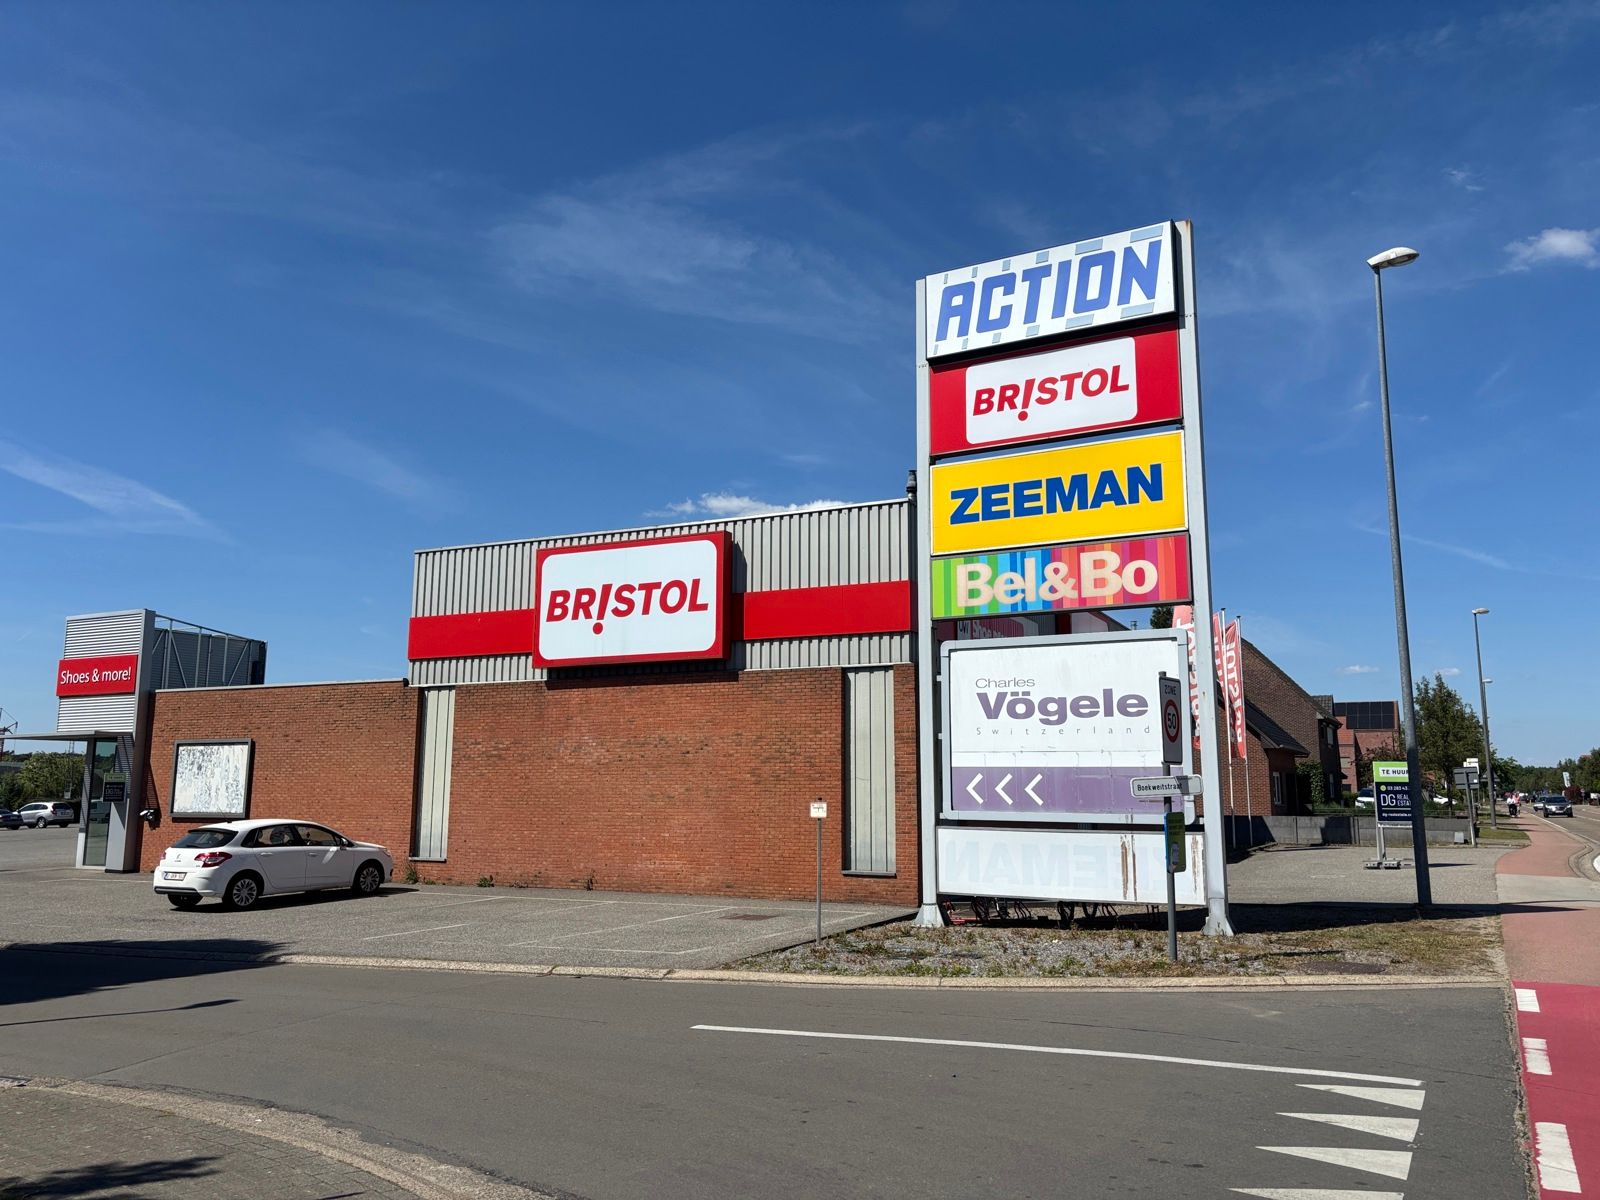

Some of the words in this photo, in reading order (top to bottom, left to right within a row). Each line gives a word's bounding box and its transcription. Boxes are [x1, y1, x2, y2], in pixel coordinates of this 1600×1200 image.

[935, 239, 1162, 342] ACTION
[950, 463, 1163, 525] ZEEMAN
[956, 550, 1158, 608] Bel&Bo
[60, 670, 90, 685] Shoes
[91, 668, 100, 682] &
[101, 666, 131, 682] more!
[975, 677, 1036, 688] Charles
[1164, 684, 1177, 696] ZONE
[976, 688, 1149, 726] Vögele
[976, 725, 1150, 736] Switzerland
[1167, 713, 1177, 730] 50
[1380, 793, 1396, 806] DG
